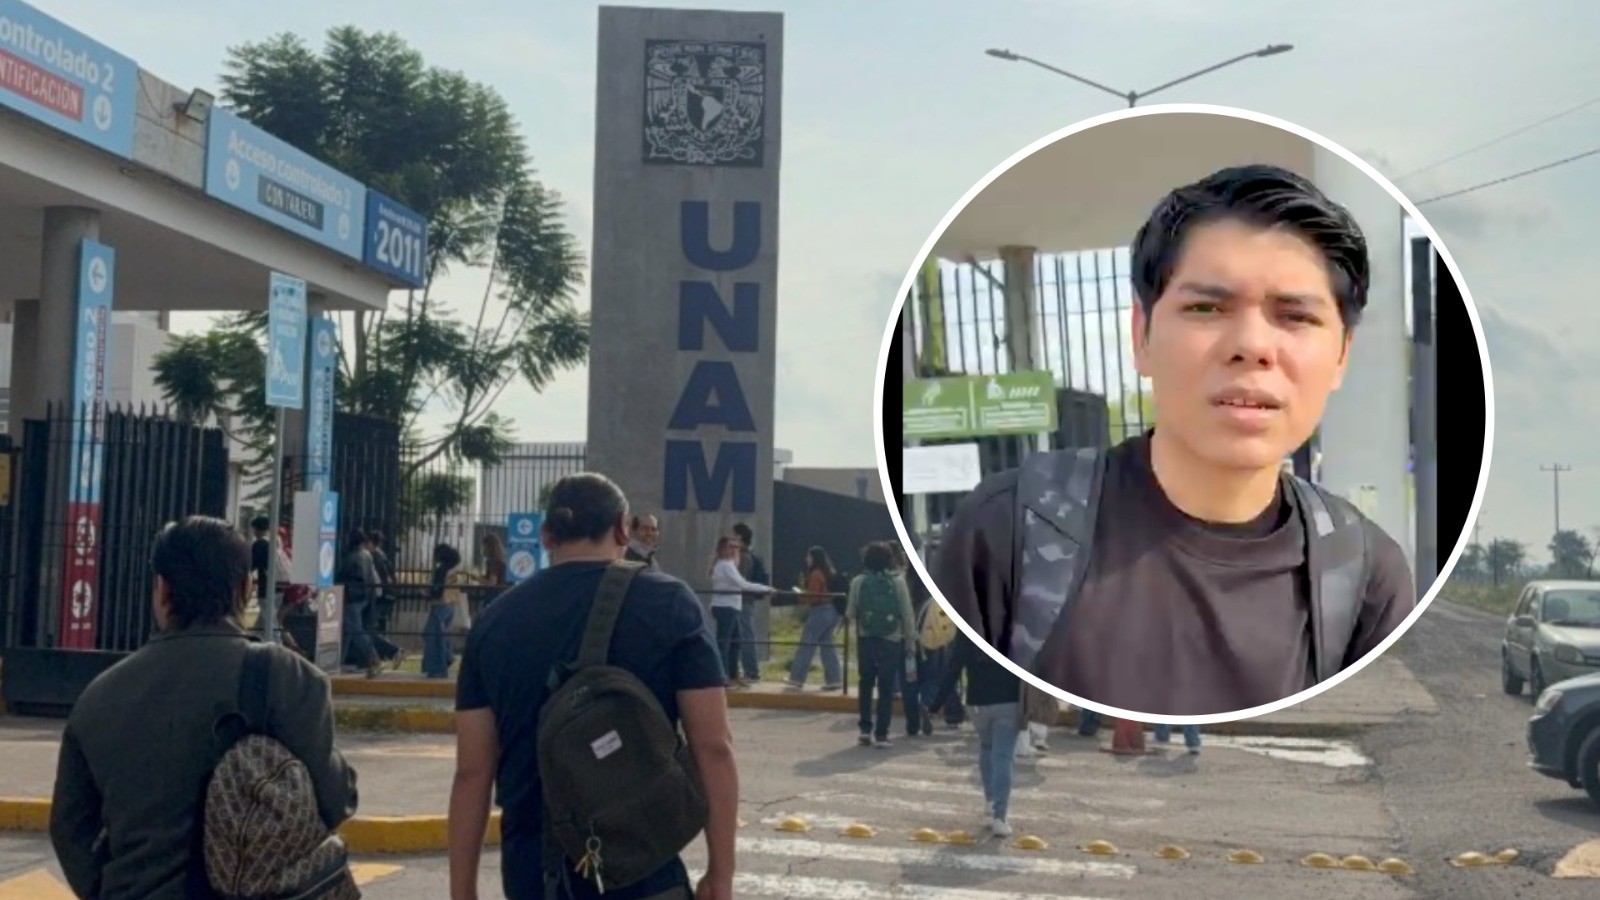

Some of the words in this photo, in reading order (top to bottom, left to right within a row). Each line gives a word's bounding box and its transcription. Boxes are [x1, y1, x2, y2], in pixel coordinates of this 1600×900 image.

[101, 62, 115, 95] 2
[226, 130, 277, 172] Acceso
[279, 160, 342, 206] controlado
[376, 219, 421, 278] 2011
[662, 200, 762, 513] UNAM
